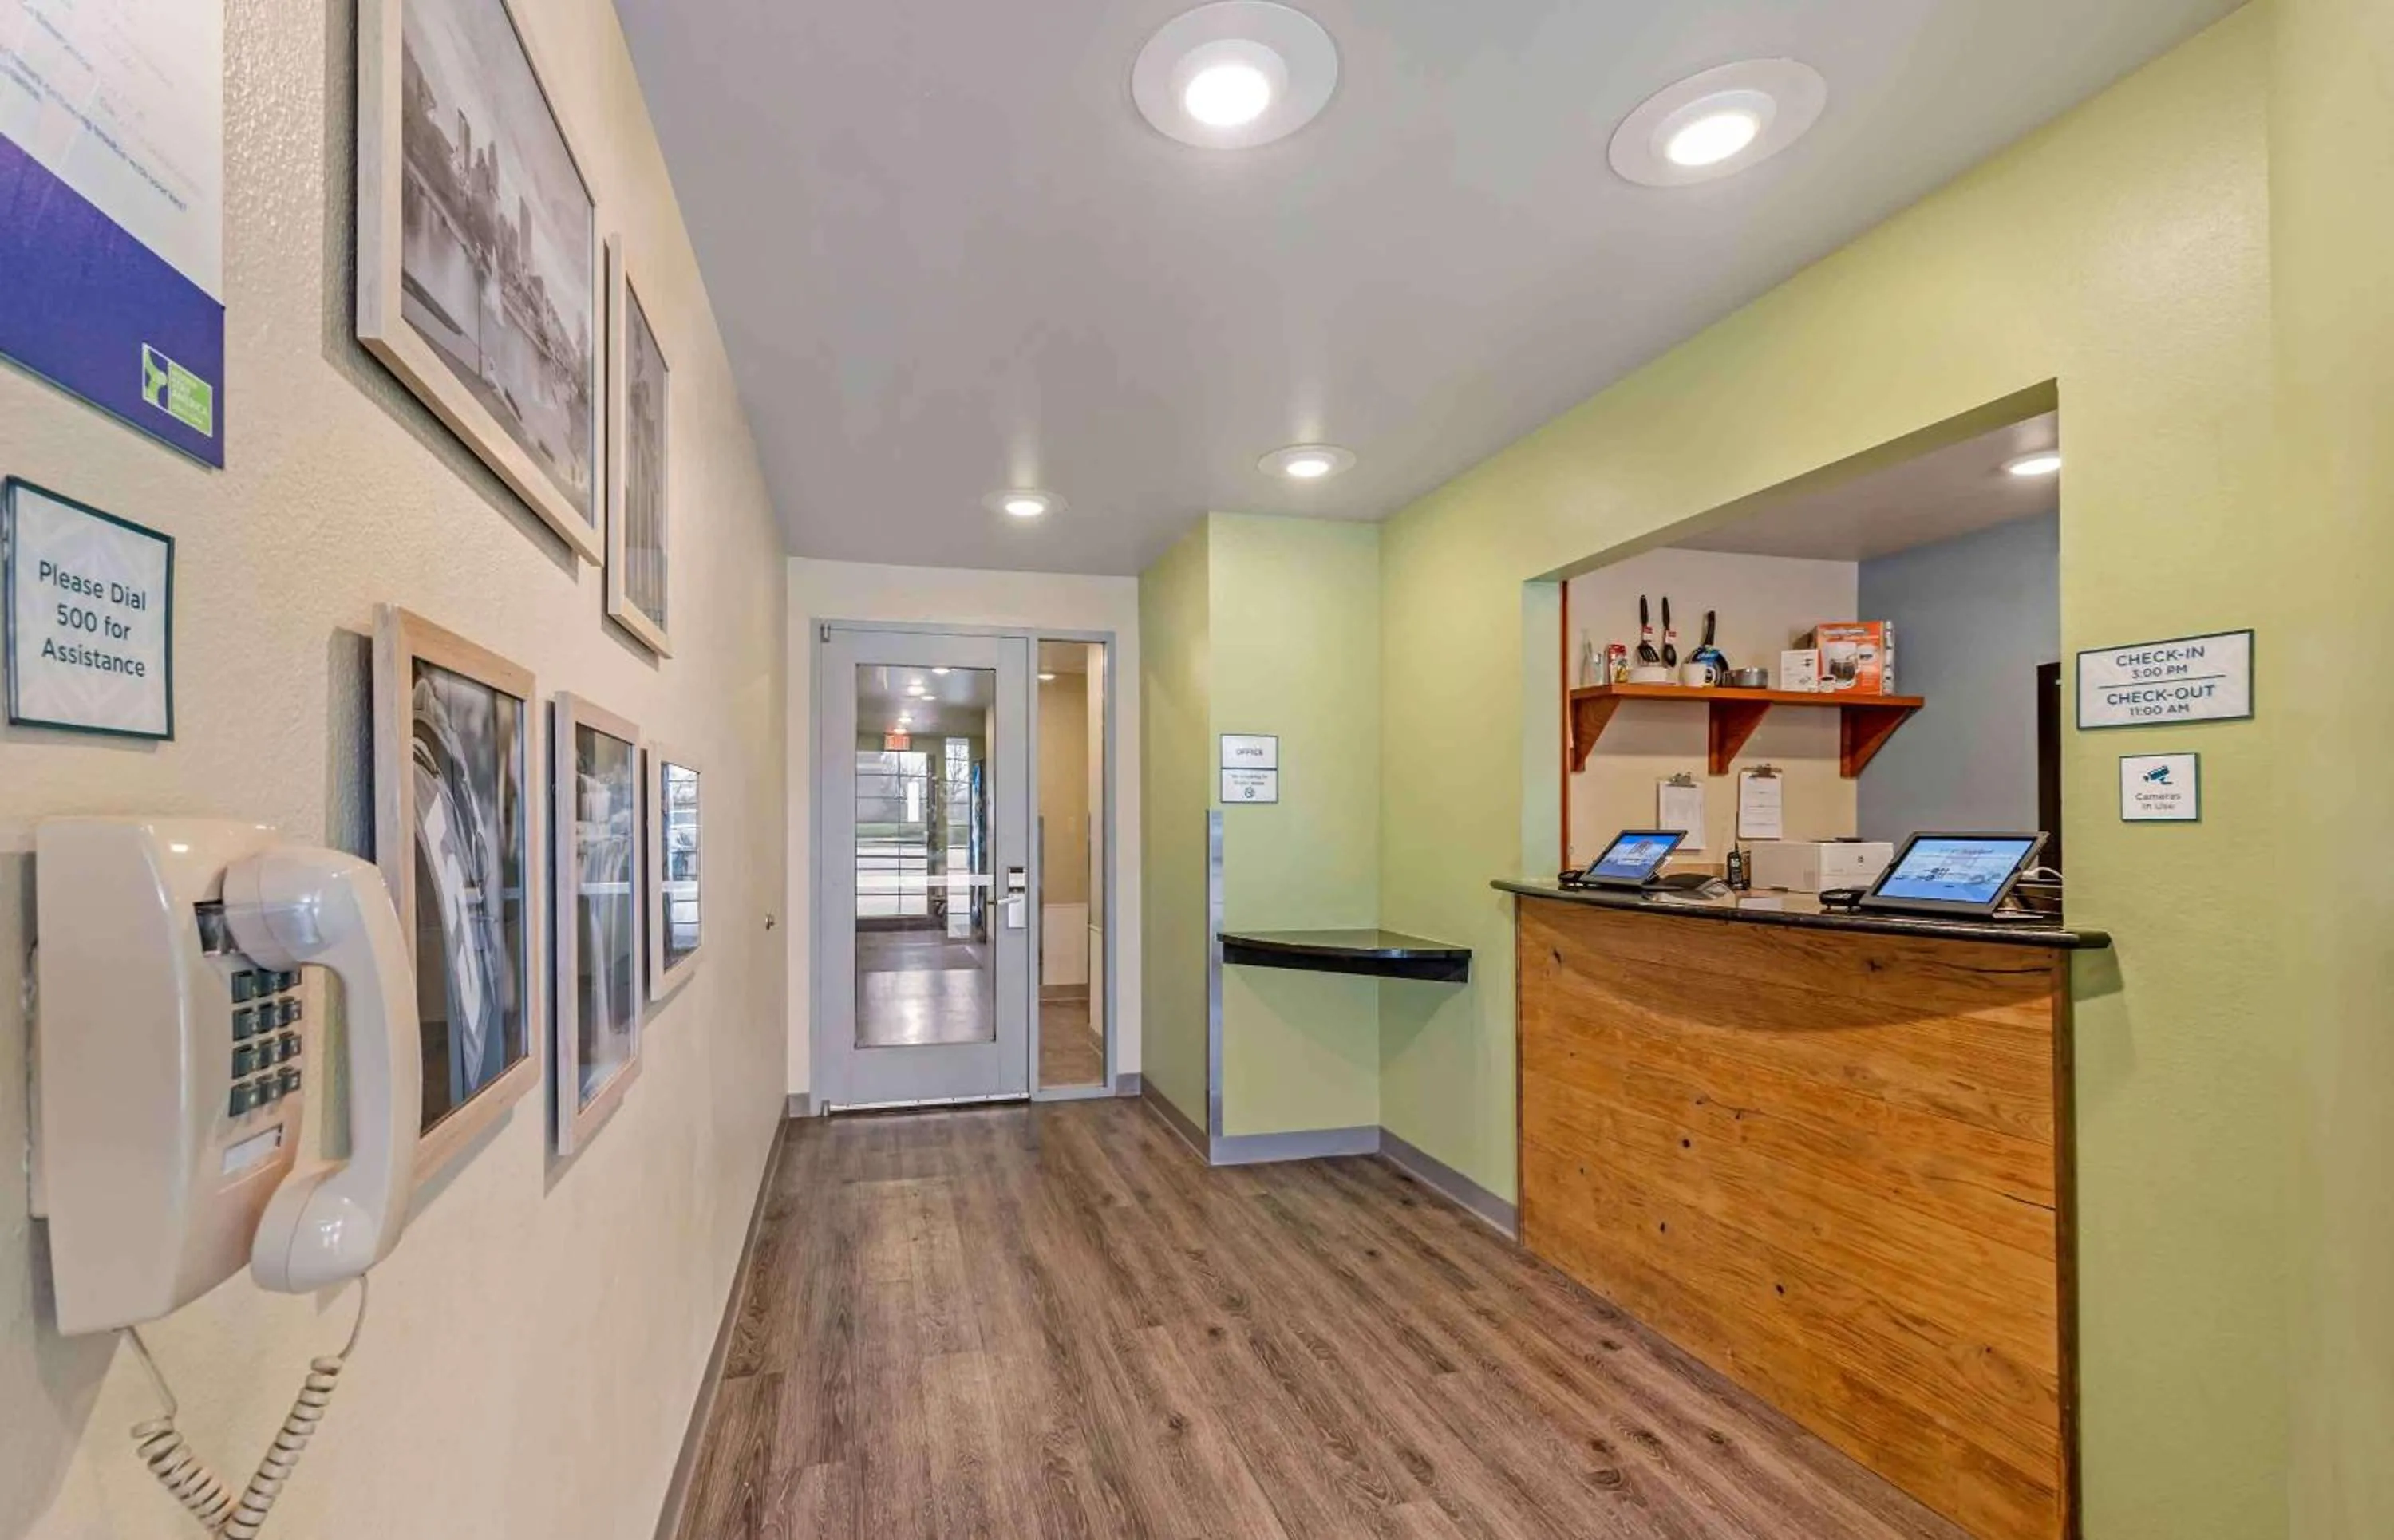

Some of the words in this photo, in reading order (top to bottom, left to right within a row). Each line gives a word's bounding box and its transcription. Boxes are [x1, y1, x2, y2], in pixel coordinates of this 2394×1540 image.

[39, 560, 104, 599] Please
[111, 583, 146, 611] Dial
[57, 604, 97, 633] 500
[105, 616, 131, 640] for
[41, 638, 145, 677] Assistance
[2116, 646, 2205, 667] CHECK-IN
[2131, 667, 2162, 679] 3:00
[2167, 664, 2188, 674] PM
[2107, 684, 2215, 705] CHECK-OUT
[2130, 705, 2163, 716] 11:00
[2167, 704, 2190, 713] AM
